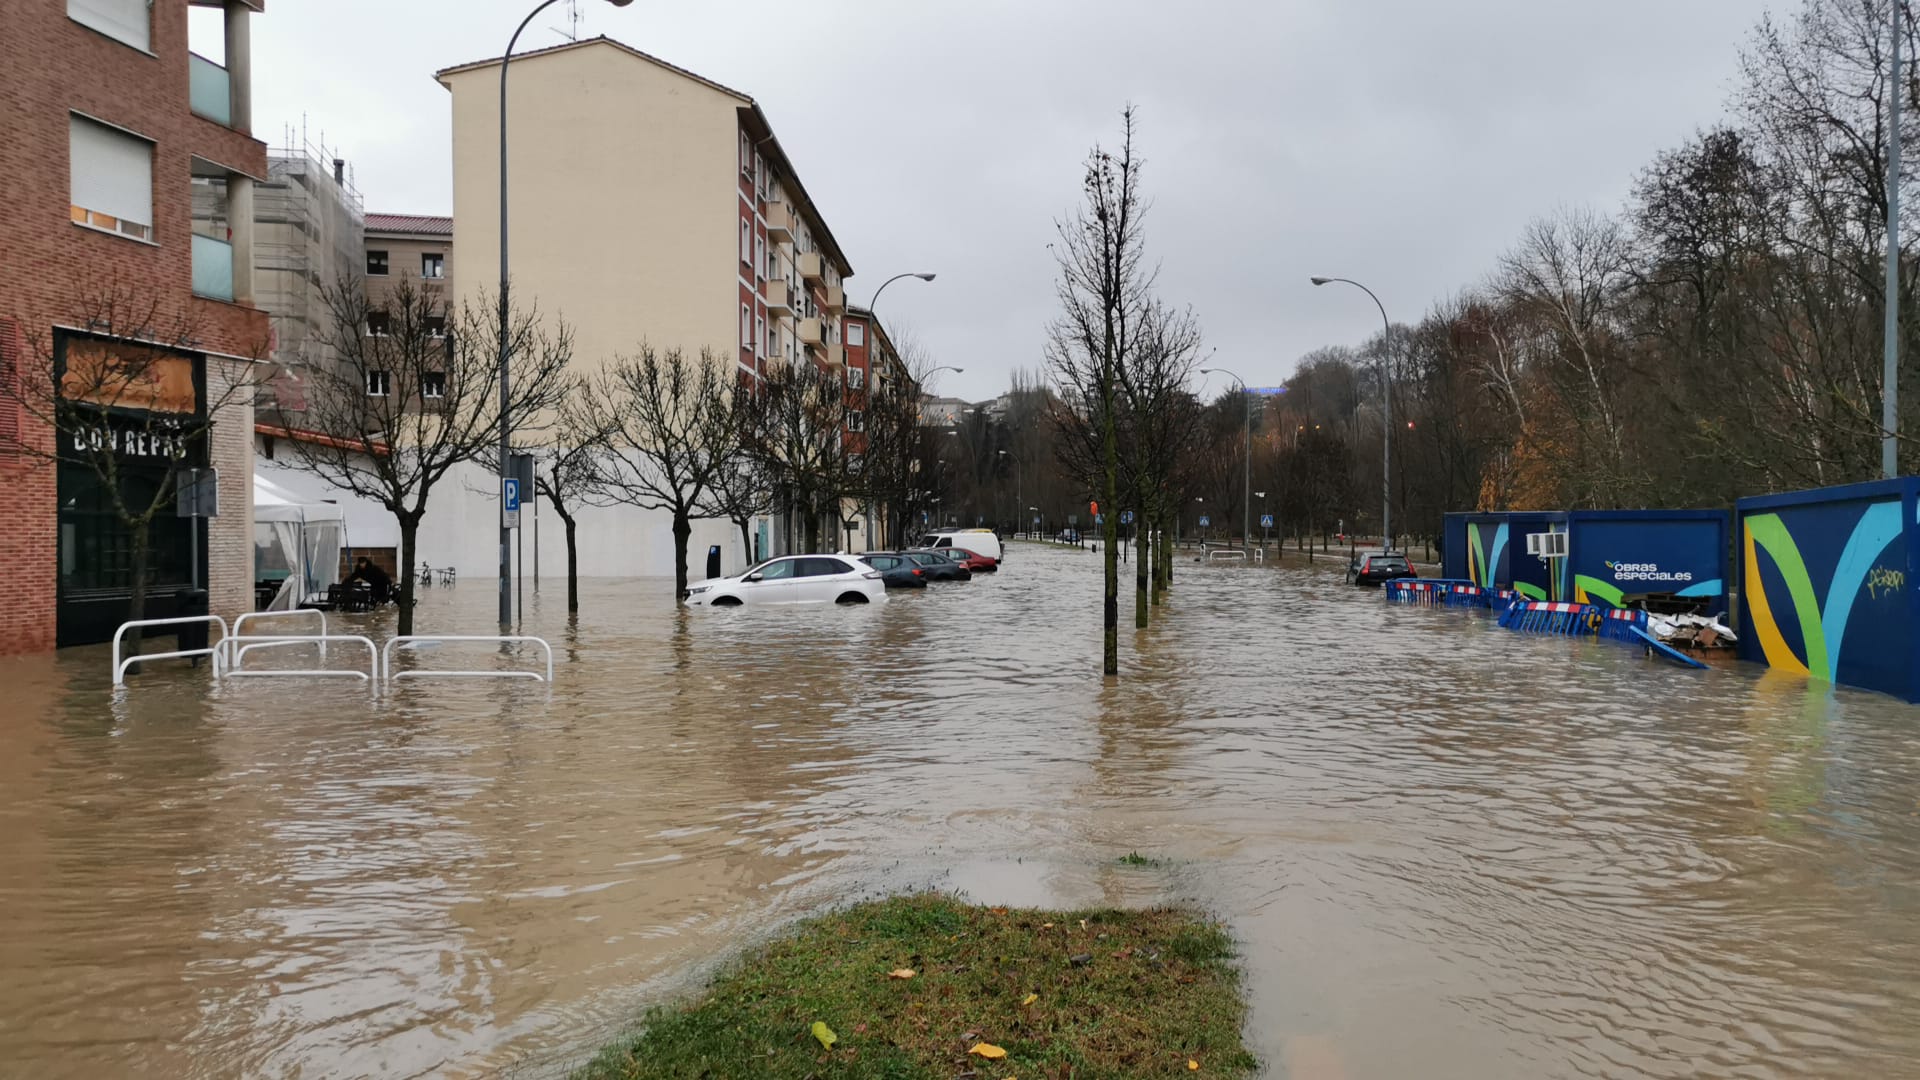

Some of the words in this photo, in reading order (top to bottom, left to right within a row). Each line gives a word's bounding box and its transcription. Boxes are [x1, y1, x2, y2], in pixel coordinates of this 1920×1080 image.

[506, 481, 516, 508] P
[1614, 563, 1658, 572] OBRAS
[1614, 572, 1692, 581] ESPECIALES
